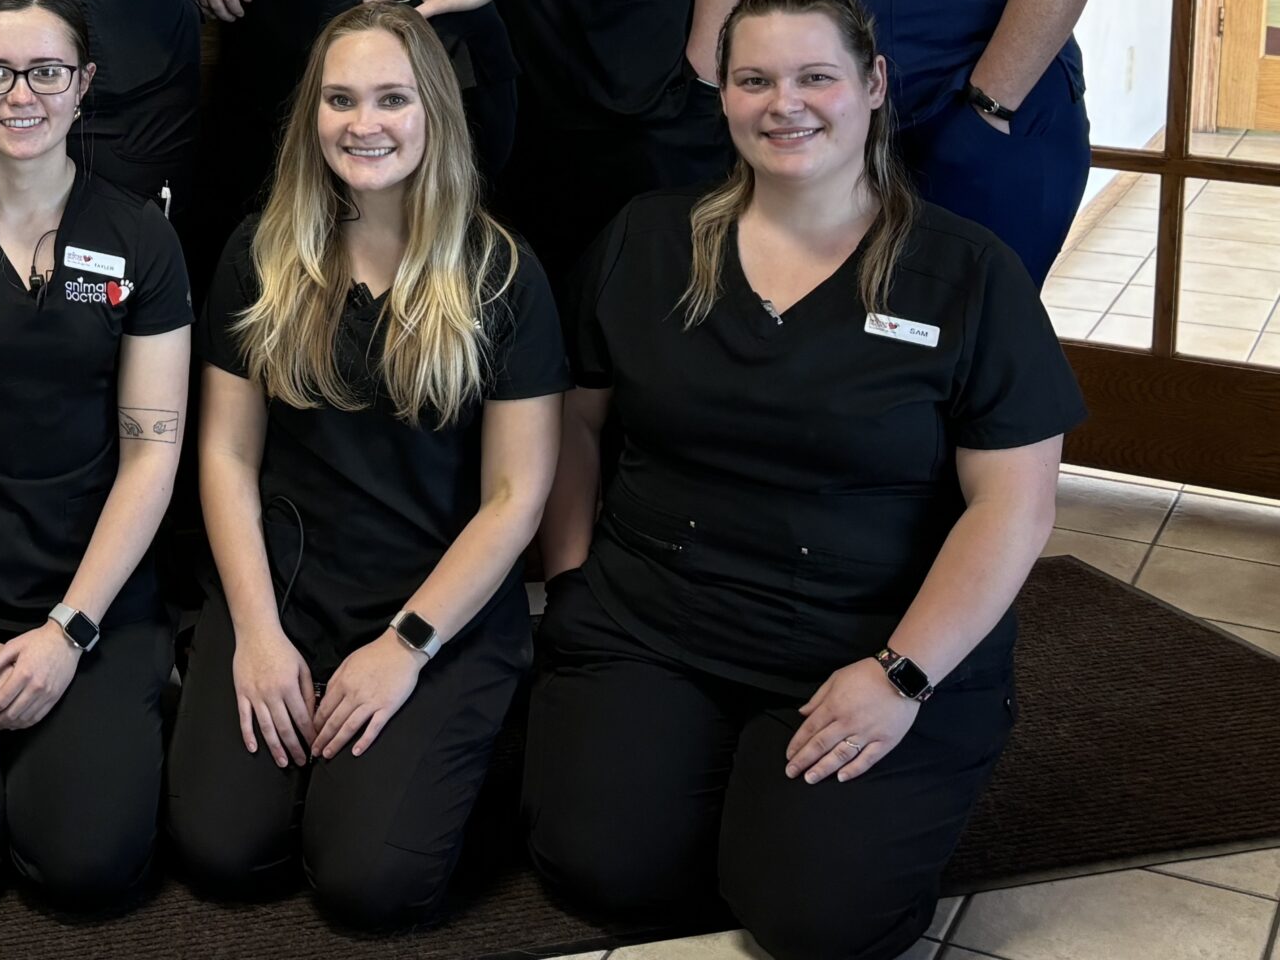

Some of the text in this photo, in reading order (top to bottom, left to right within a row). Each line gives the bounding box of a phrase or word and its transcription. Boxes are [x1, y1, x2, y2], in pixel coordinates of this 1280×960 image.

[65, 276, 107, 293] animal
[65, 290, 107, 304] DOCTOR
[909, 328, 929, 337] SAM
